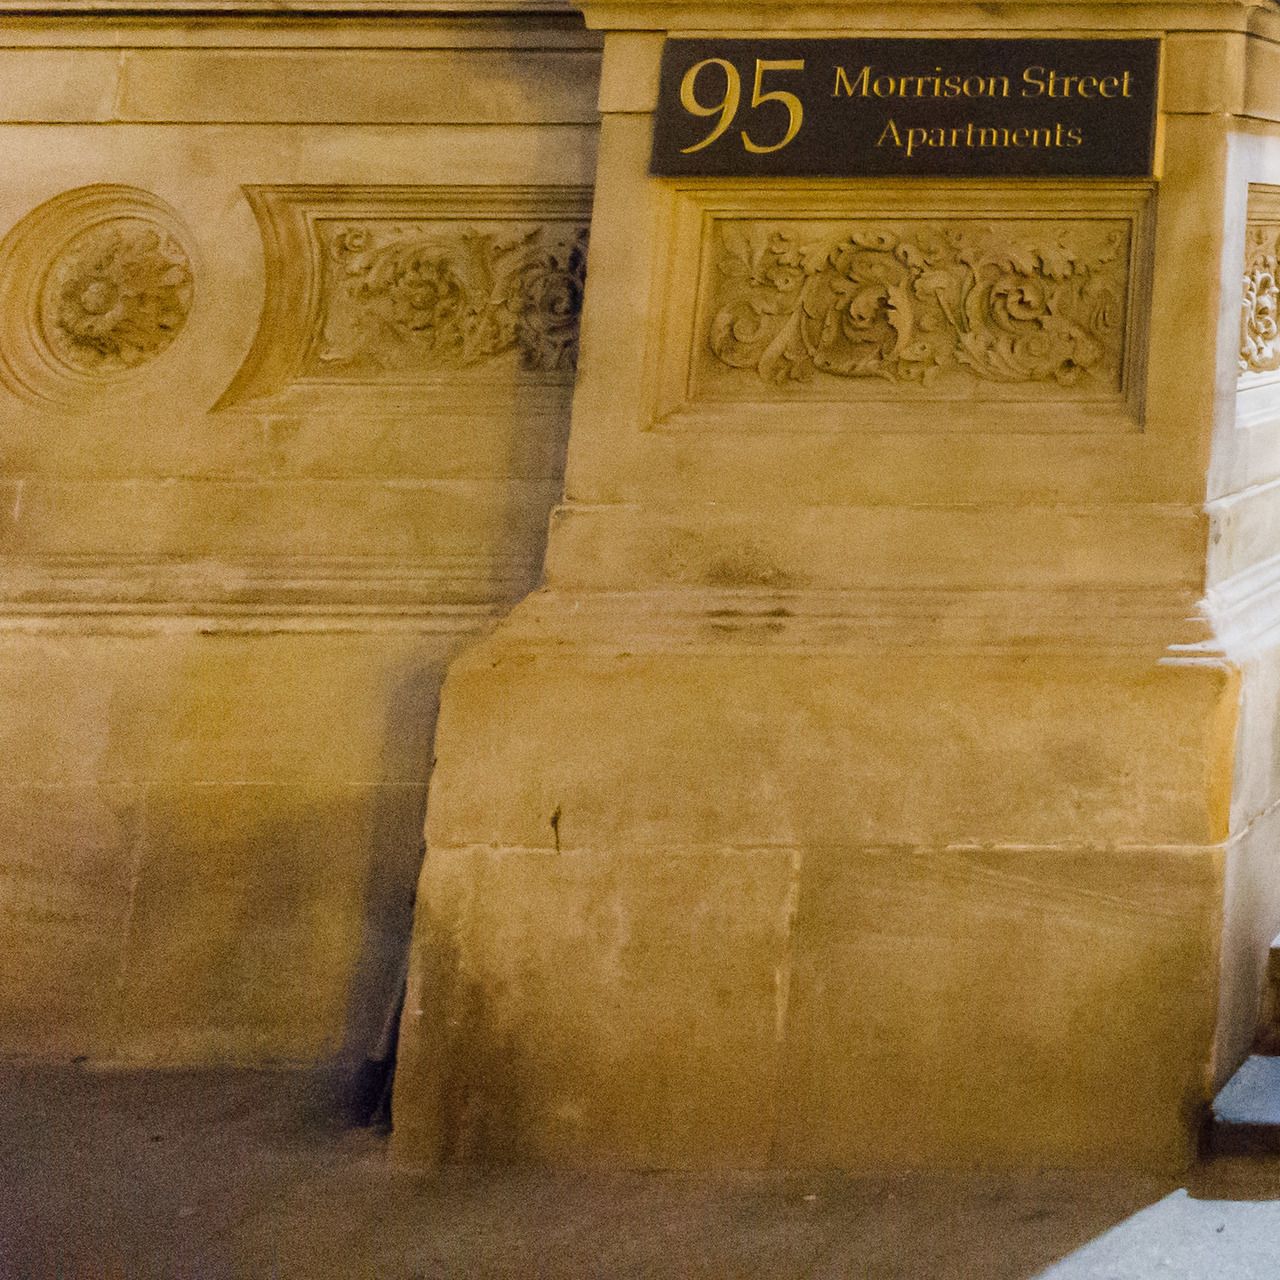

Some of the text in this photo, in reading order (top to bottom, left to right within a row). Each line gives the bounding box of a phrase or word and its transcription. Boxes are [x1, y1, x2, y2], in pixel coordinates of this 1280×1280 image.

[832, 65, 1134, 99] Morrison Street
[678, 58, 805, 154] 95
[877, 119, 1083, 157] Apartments
